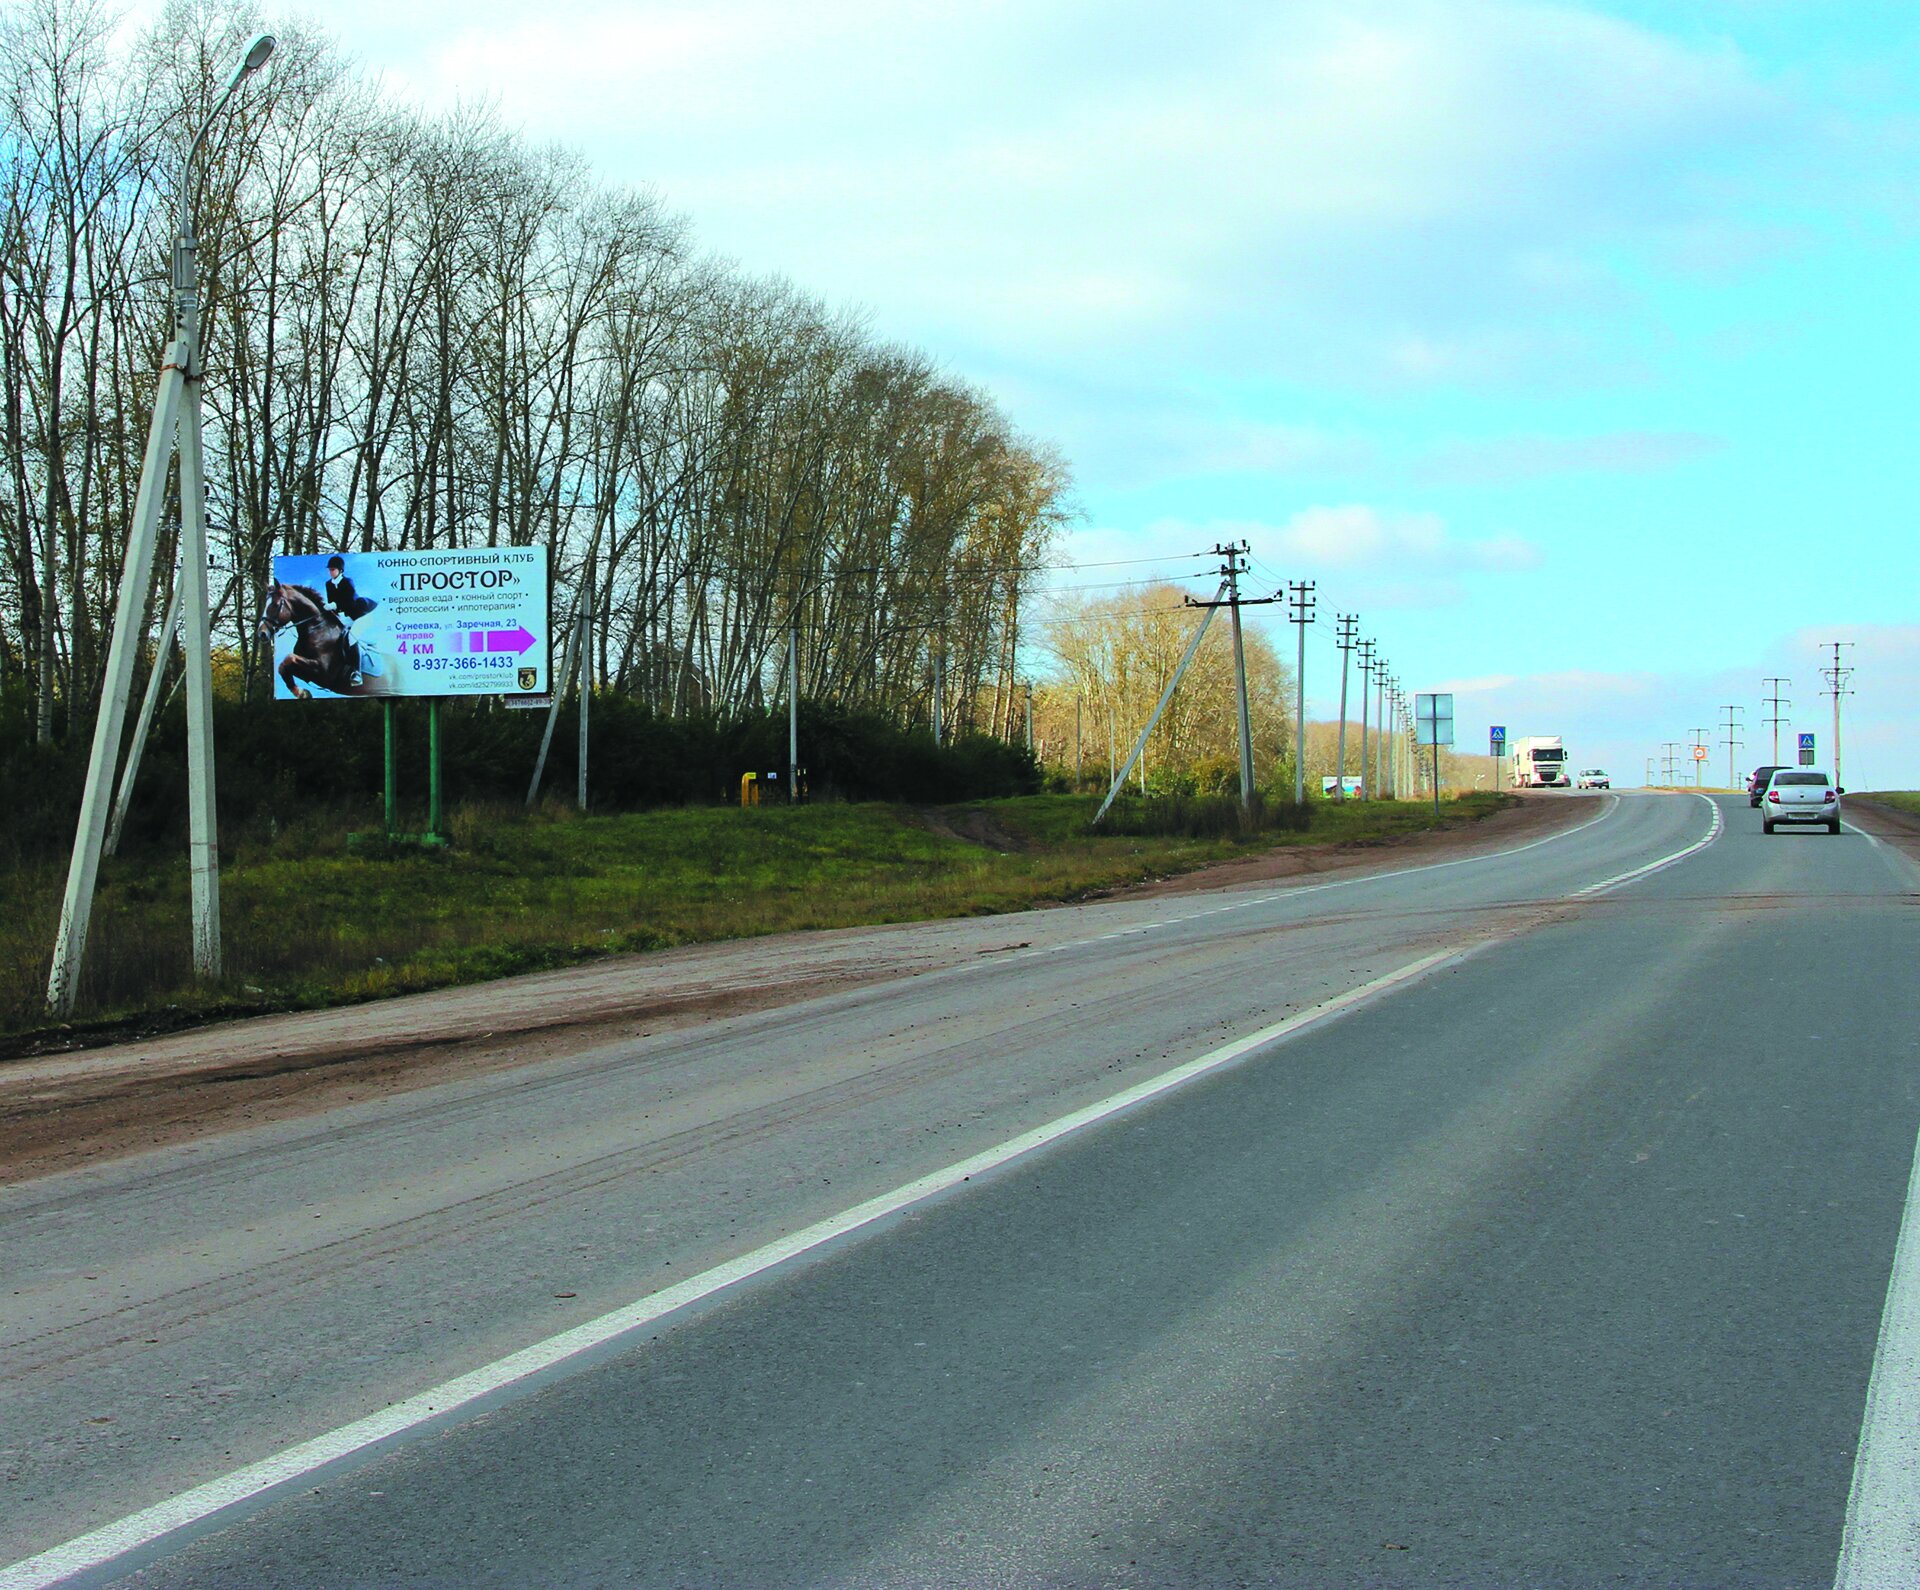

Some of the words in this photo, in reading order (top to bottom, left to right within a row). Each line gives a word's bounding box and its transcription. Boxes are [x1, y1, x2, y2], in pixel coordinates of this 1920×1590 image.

[503, 553, 535, 565] КЛУБ
[390, 570, 520, 591] «ПРОСТОР»
[388, 595, 430, 605] верховая
[432, 594, 453, 603] езда
[461, 592, 495, 601] конный
[497, 592, 523, 602] спорт
[395, 605, 449, 615] фотосессии
[457, 603, 516, 613] иппотерапия
[395, 622, 442, 632] Сунеевка,
[456, 619, 504, 630] Заречная,
[506, 618, 517, 628] 23
[396, 632, 434, 641] направо
[397, 641, 408, 655] 4
[413, 656, 514, 671] 8-937-366-1433
